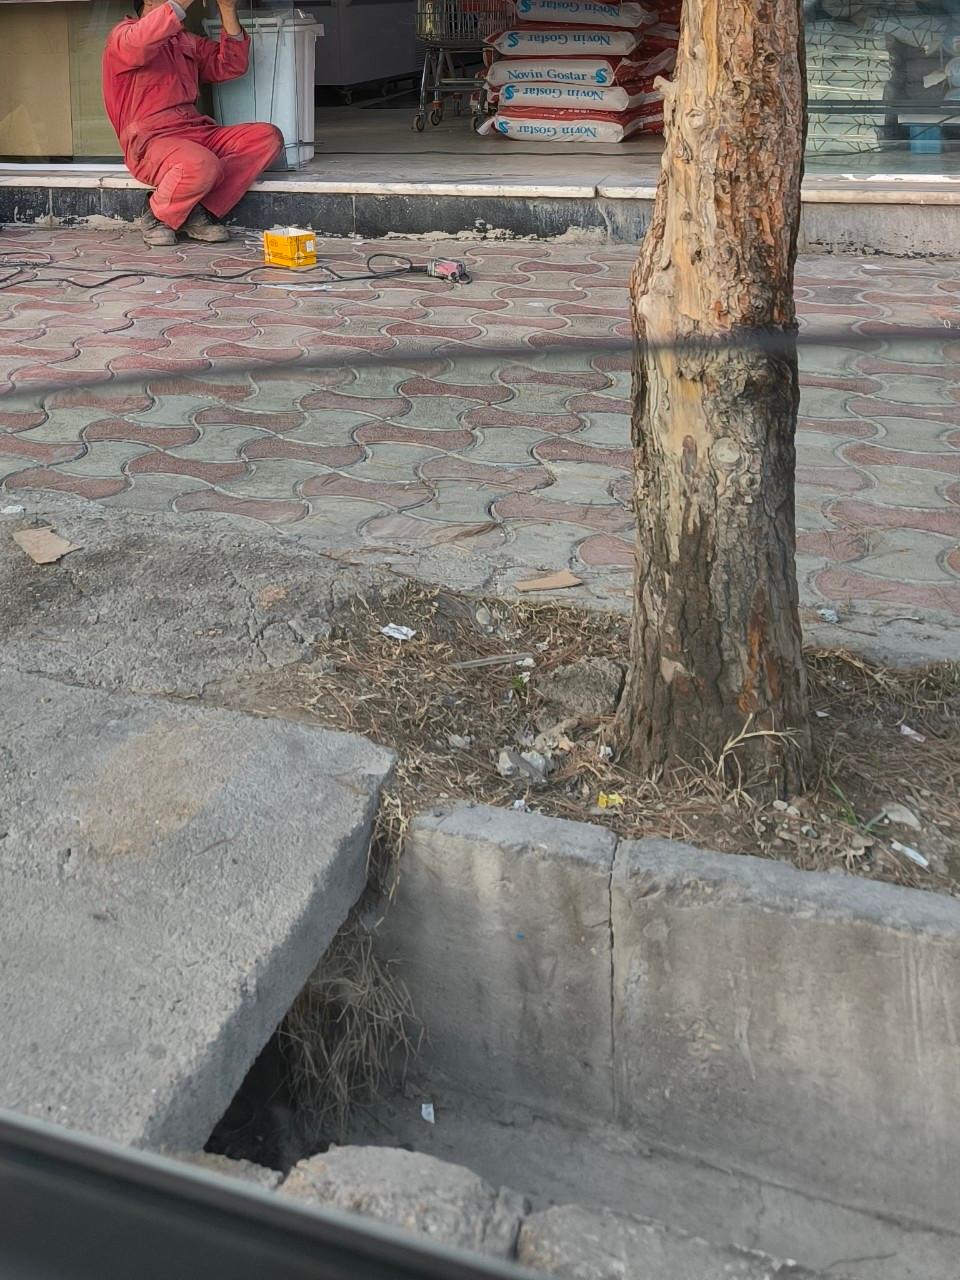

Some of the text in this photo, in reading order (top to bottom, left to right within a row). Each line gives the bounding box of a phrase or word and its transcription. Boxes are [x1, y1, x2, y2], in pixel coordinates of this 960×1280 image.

[538, 0, 620, 16] Novin Gostar
[528, 34, 611, 46] Novin Gostar
[507, 70, 588, 80] Novin Gostar
[522, 86, 606, 100] Novin Gostar
[516, 125, 598, 138] Novin Gostar
